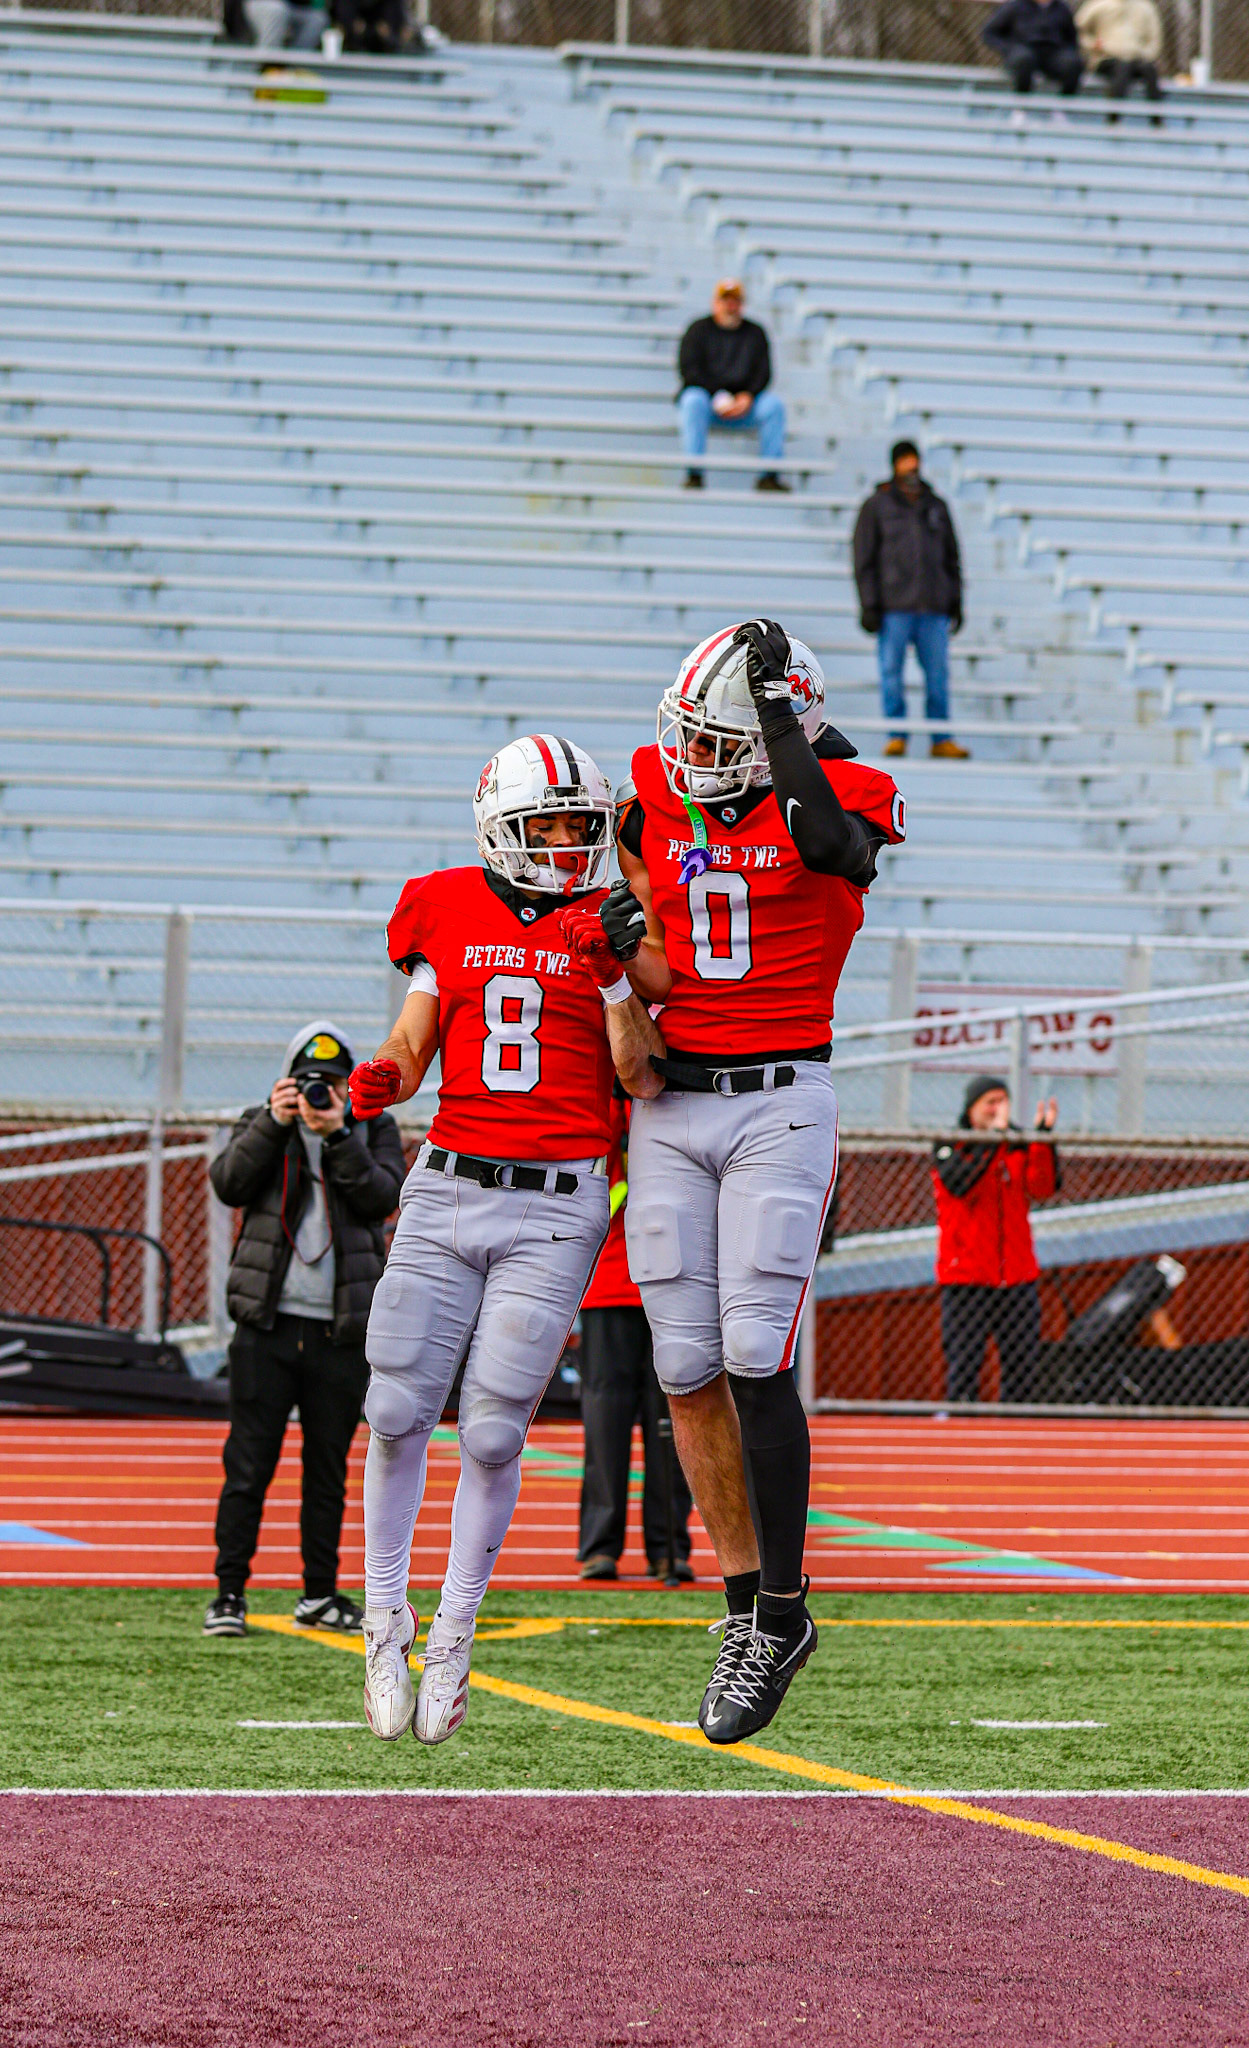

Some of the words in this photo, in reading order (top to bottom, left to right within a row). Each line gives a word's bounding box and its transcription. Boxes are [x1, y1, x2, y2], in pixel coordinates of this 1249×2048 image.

[892, 790, 907, 838] 0
[666, 839, 732, 864] PERS
[741, 845, 781, 868] TWP.
[688, 869, 752, 980] 0
[462, 944, 526, 968] PETERS
[534, 949, 571, 976] TWP.
[481, 973, 545, 1094] 8
